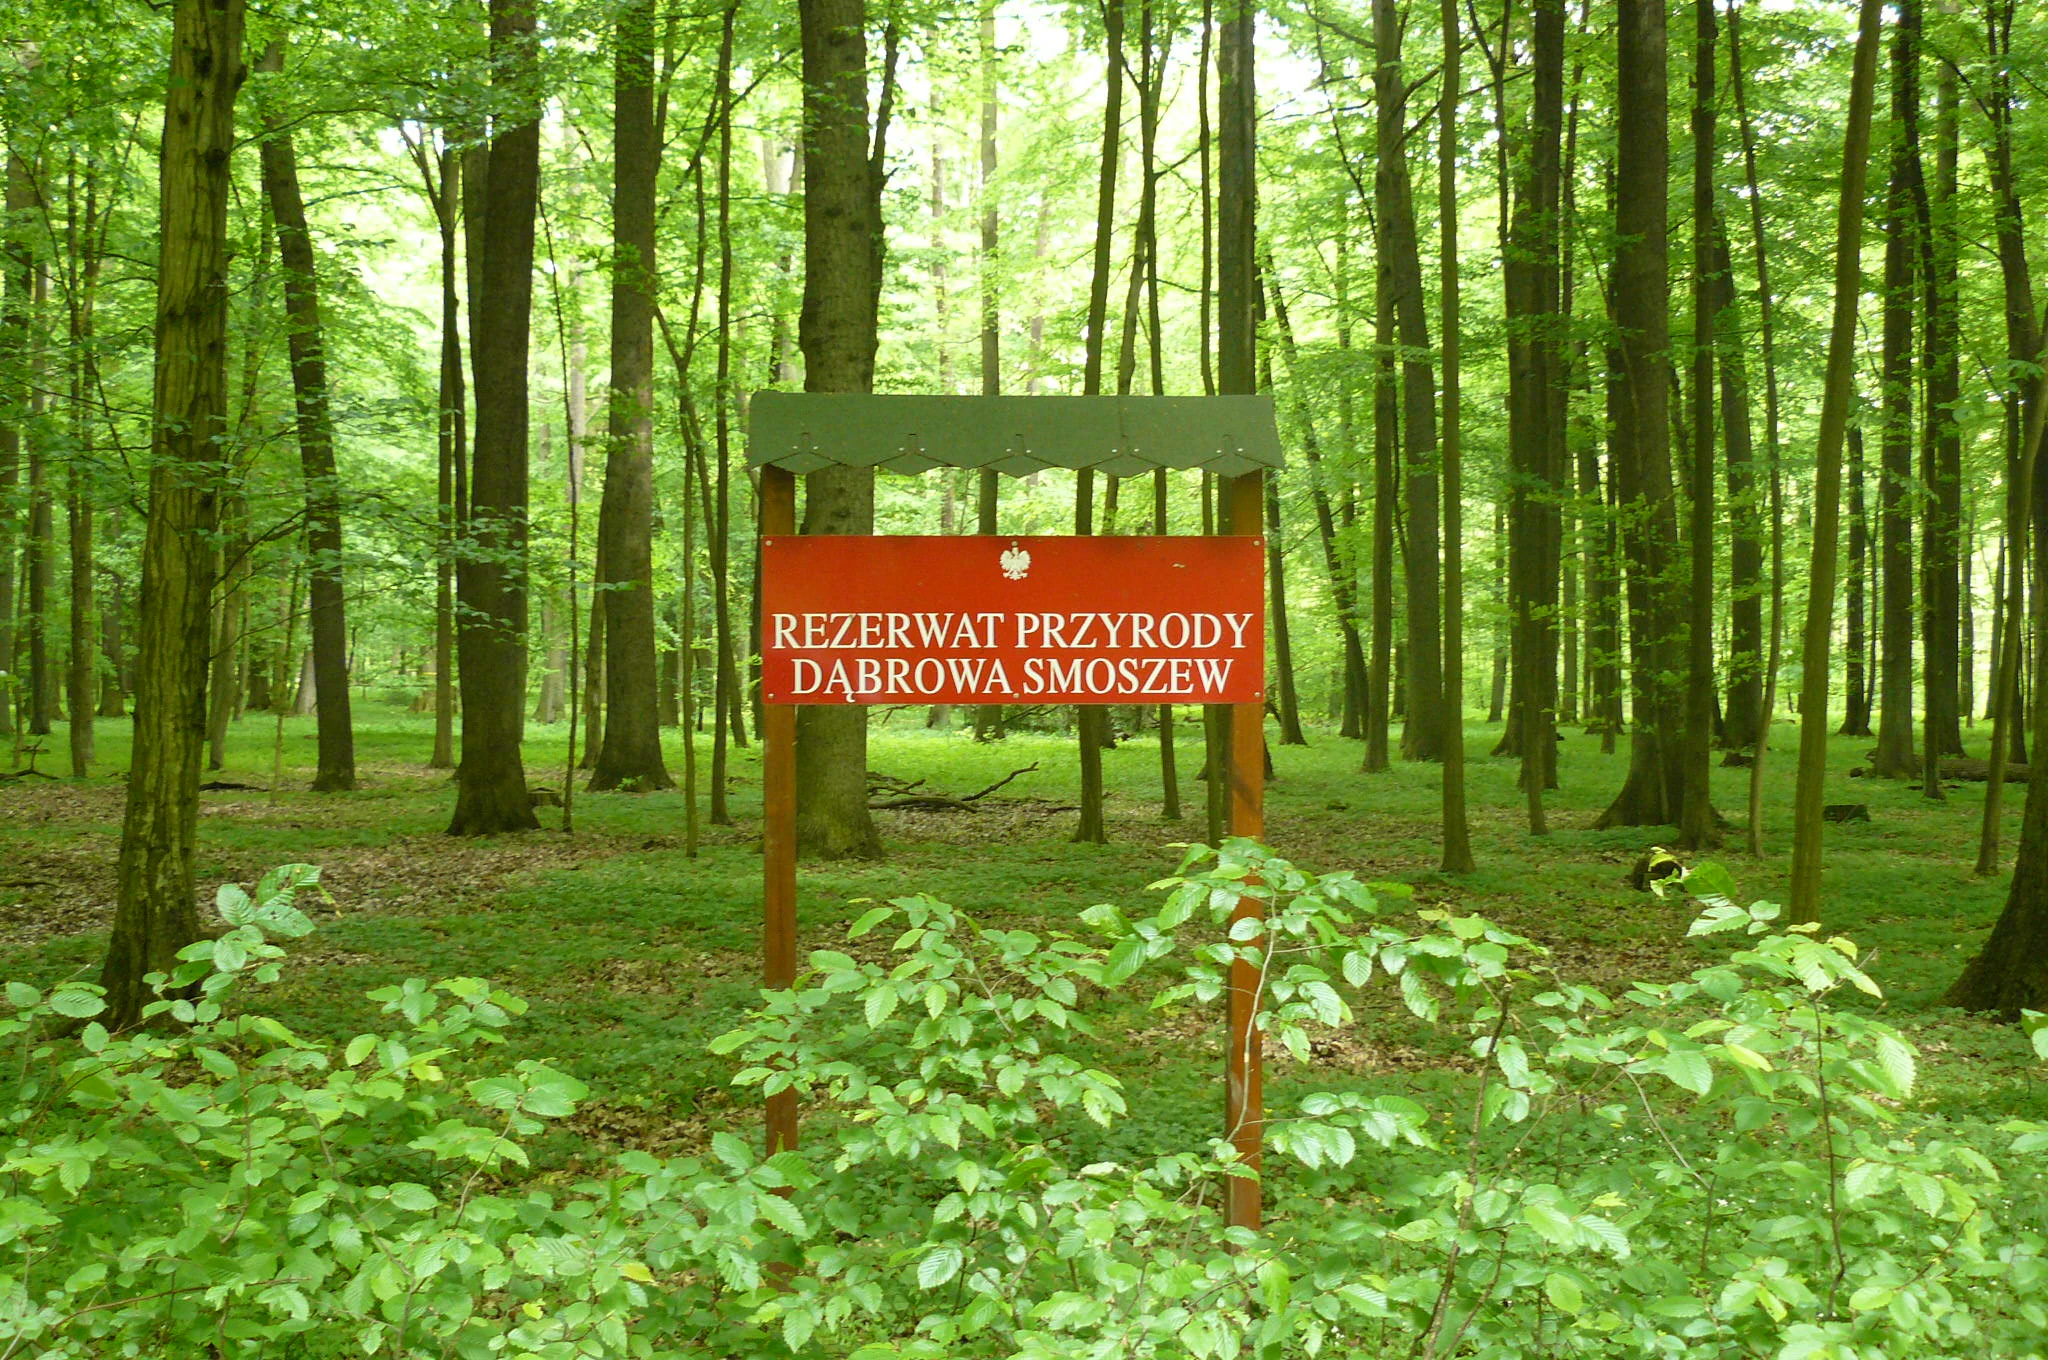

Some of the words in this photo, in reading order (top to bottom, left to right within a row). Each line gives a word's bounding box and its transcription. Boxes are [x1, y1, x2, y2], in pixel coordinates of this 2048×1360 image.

[771, 613, 1004, 649] REZERWAT
[1014, 613, 1254, 649] PRZYRODY
[791, 658, 1011, 702] DĄBROWA
[1023, 658, 1234, 694] SMOSZEW
